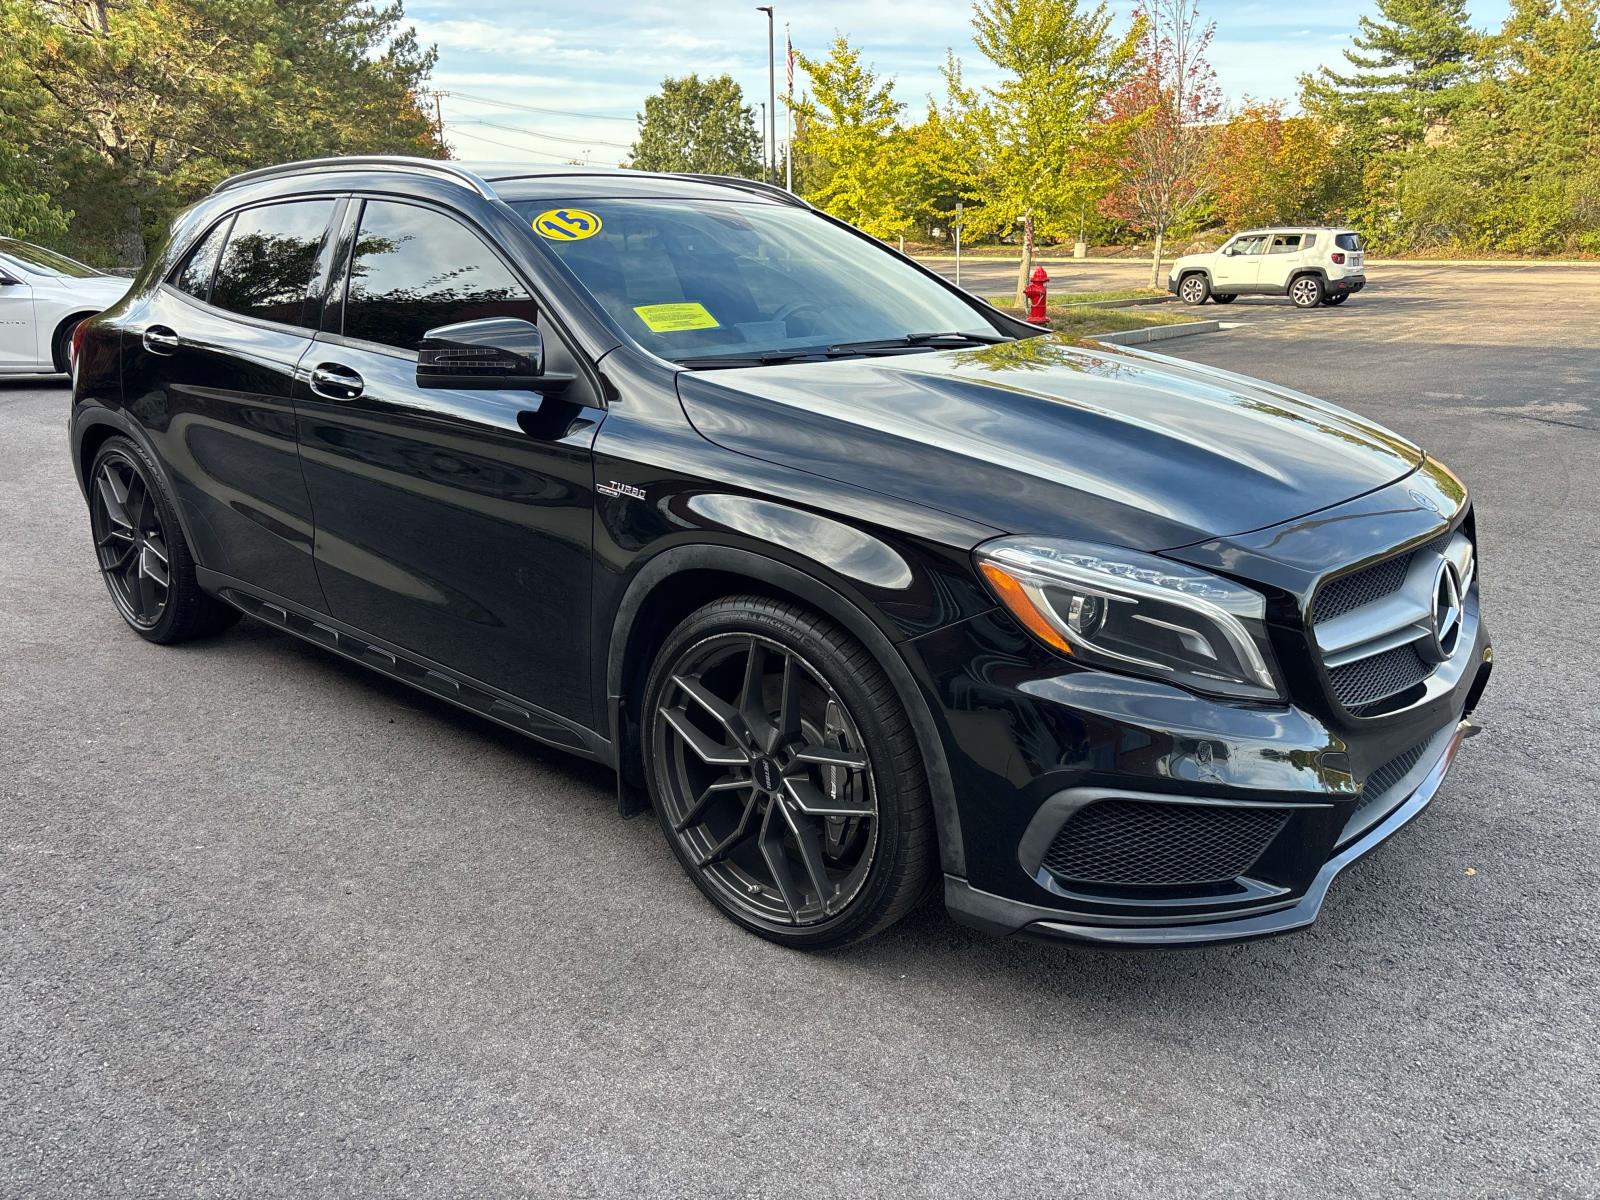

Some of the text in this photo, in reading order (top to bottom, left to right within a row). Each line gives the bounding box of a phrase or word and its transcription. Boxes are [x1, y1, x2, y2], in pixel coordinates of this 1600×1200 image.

[542, 210, 590, 238] 15
[609, 480, 647, 498] TURBO
[758, 615, 803, 640] MICHELIN
